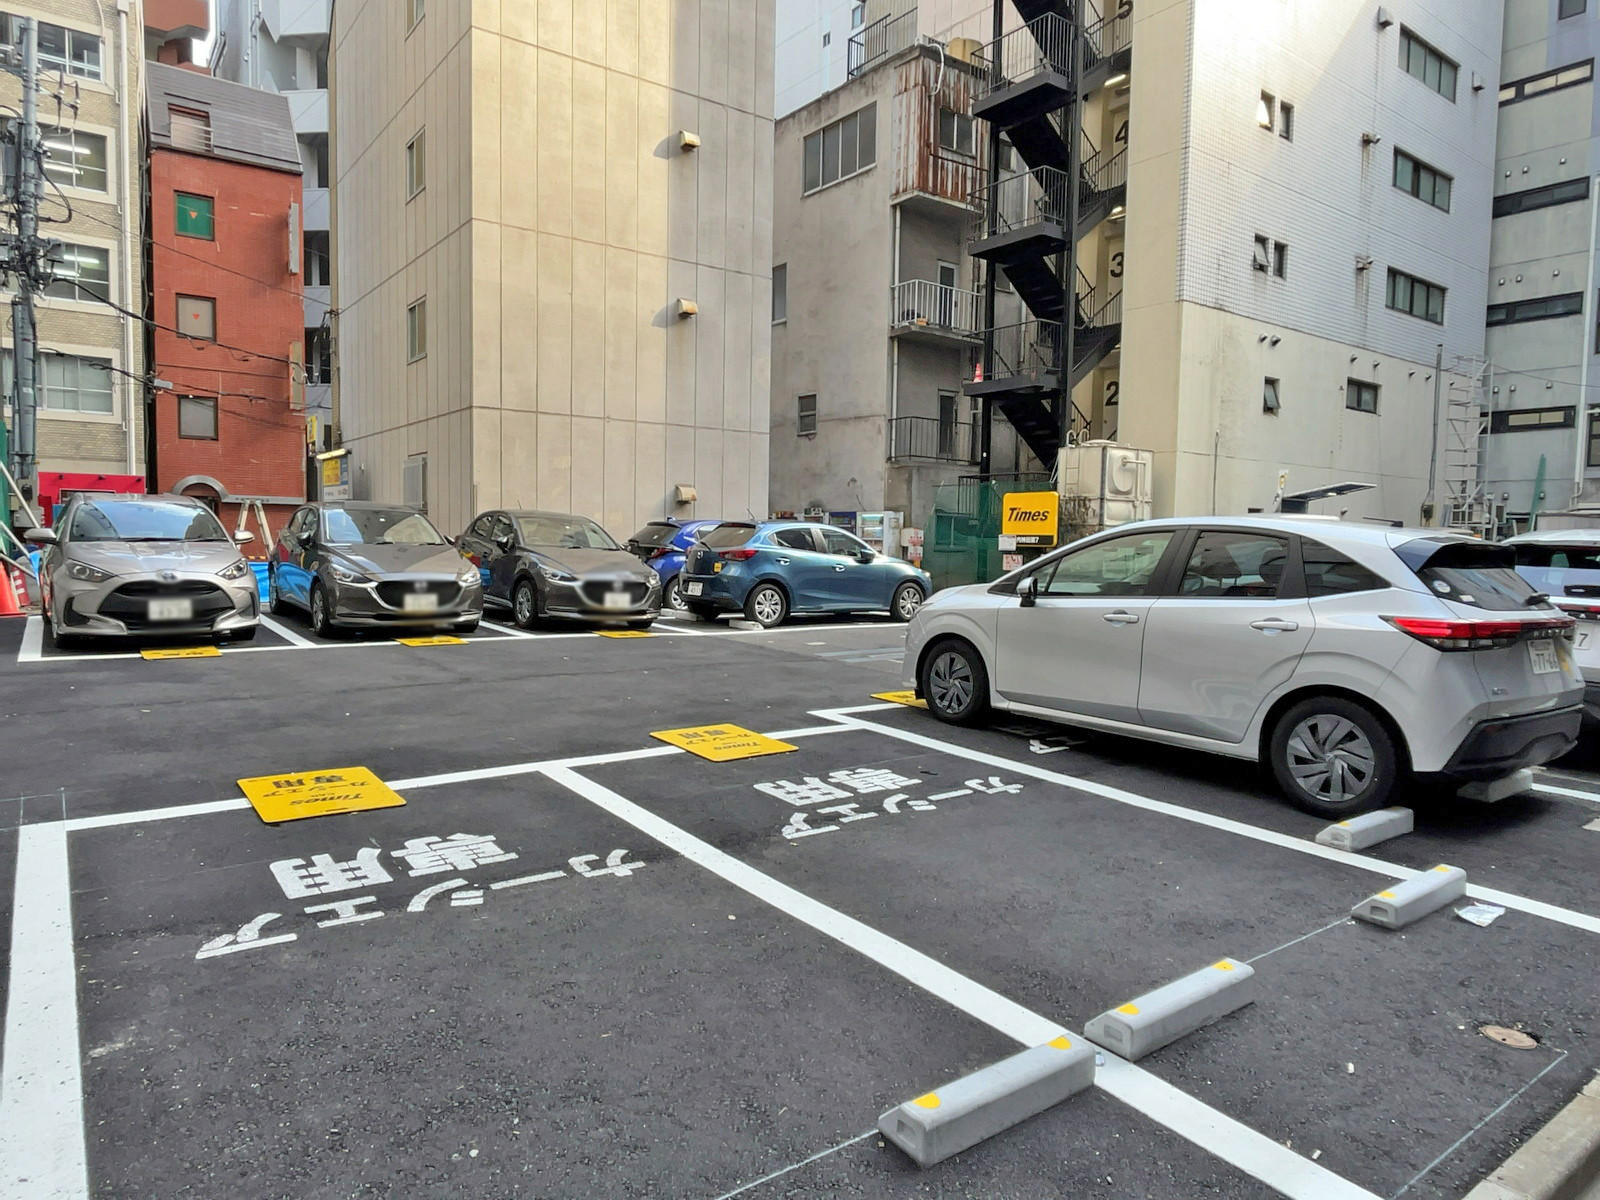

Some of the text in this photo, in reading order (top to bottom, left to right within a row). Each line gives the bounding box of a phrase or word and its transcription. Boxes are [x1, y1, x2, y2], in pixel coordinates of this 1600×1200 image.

[1118, 0, 1134, 19] 5
[1114, 119, 1128, 145] 4
[1110, 251, 1124, 278] 3
[1104, 381, 1120, 407] 2
[1008, 507, 1050, 522] Times
[713, 741, 761, 751] Times
[262, 781, 371, 798] カーシェア
[289, 792, 365, 806] Times
[753, 768, 922, 807] 専用
[781, 776, 1024, 840] カーシェア
[269, 833, 518, 900] 専用
[195, 849, 646, 960] カーシェア
